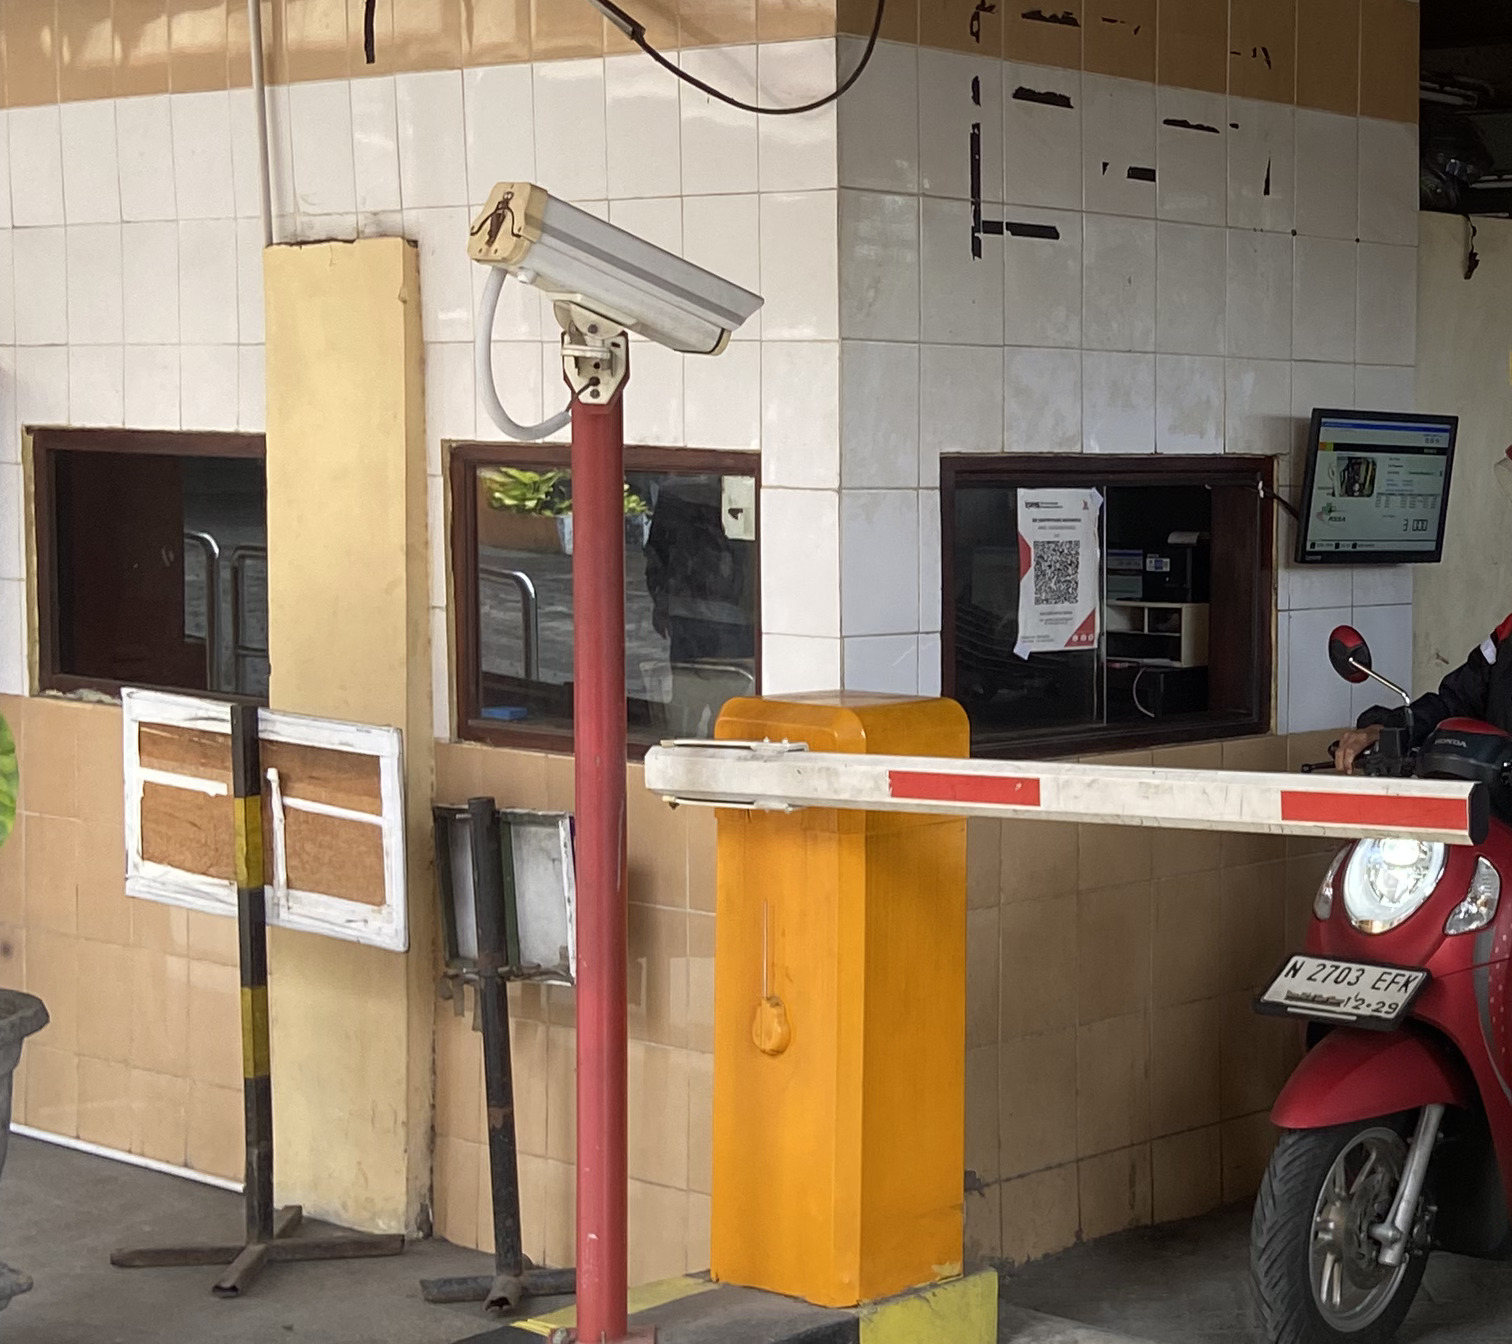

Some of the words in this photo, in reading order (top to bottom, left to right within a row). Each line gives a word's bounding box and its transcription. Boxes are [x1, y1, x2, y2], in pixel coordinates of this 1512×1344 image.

[1434, 738, 1468, 748] HONDA
[1284, 959, 1305, 979] N
[1307, 963, 1366, 987] 2703
[1371, 971, 1419, 994] EFK
